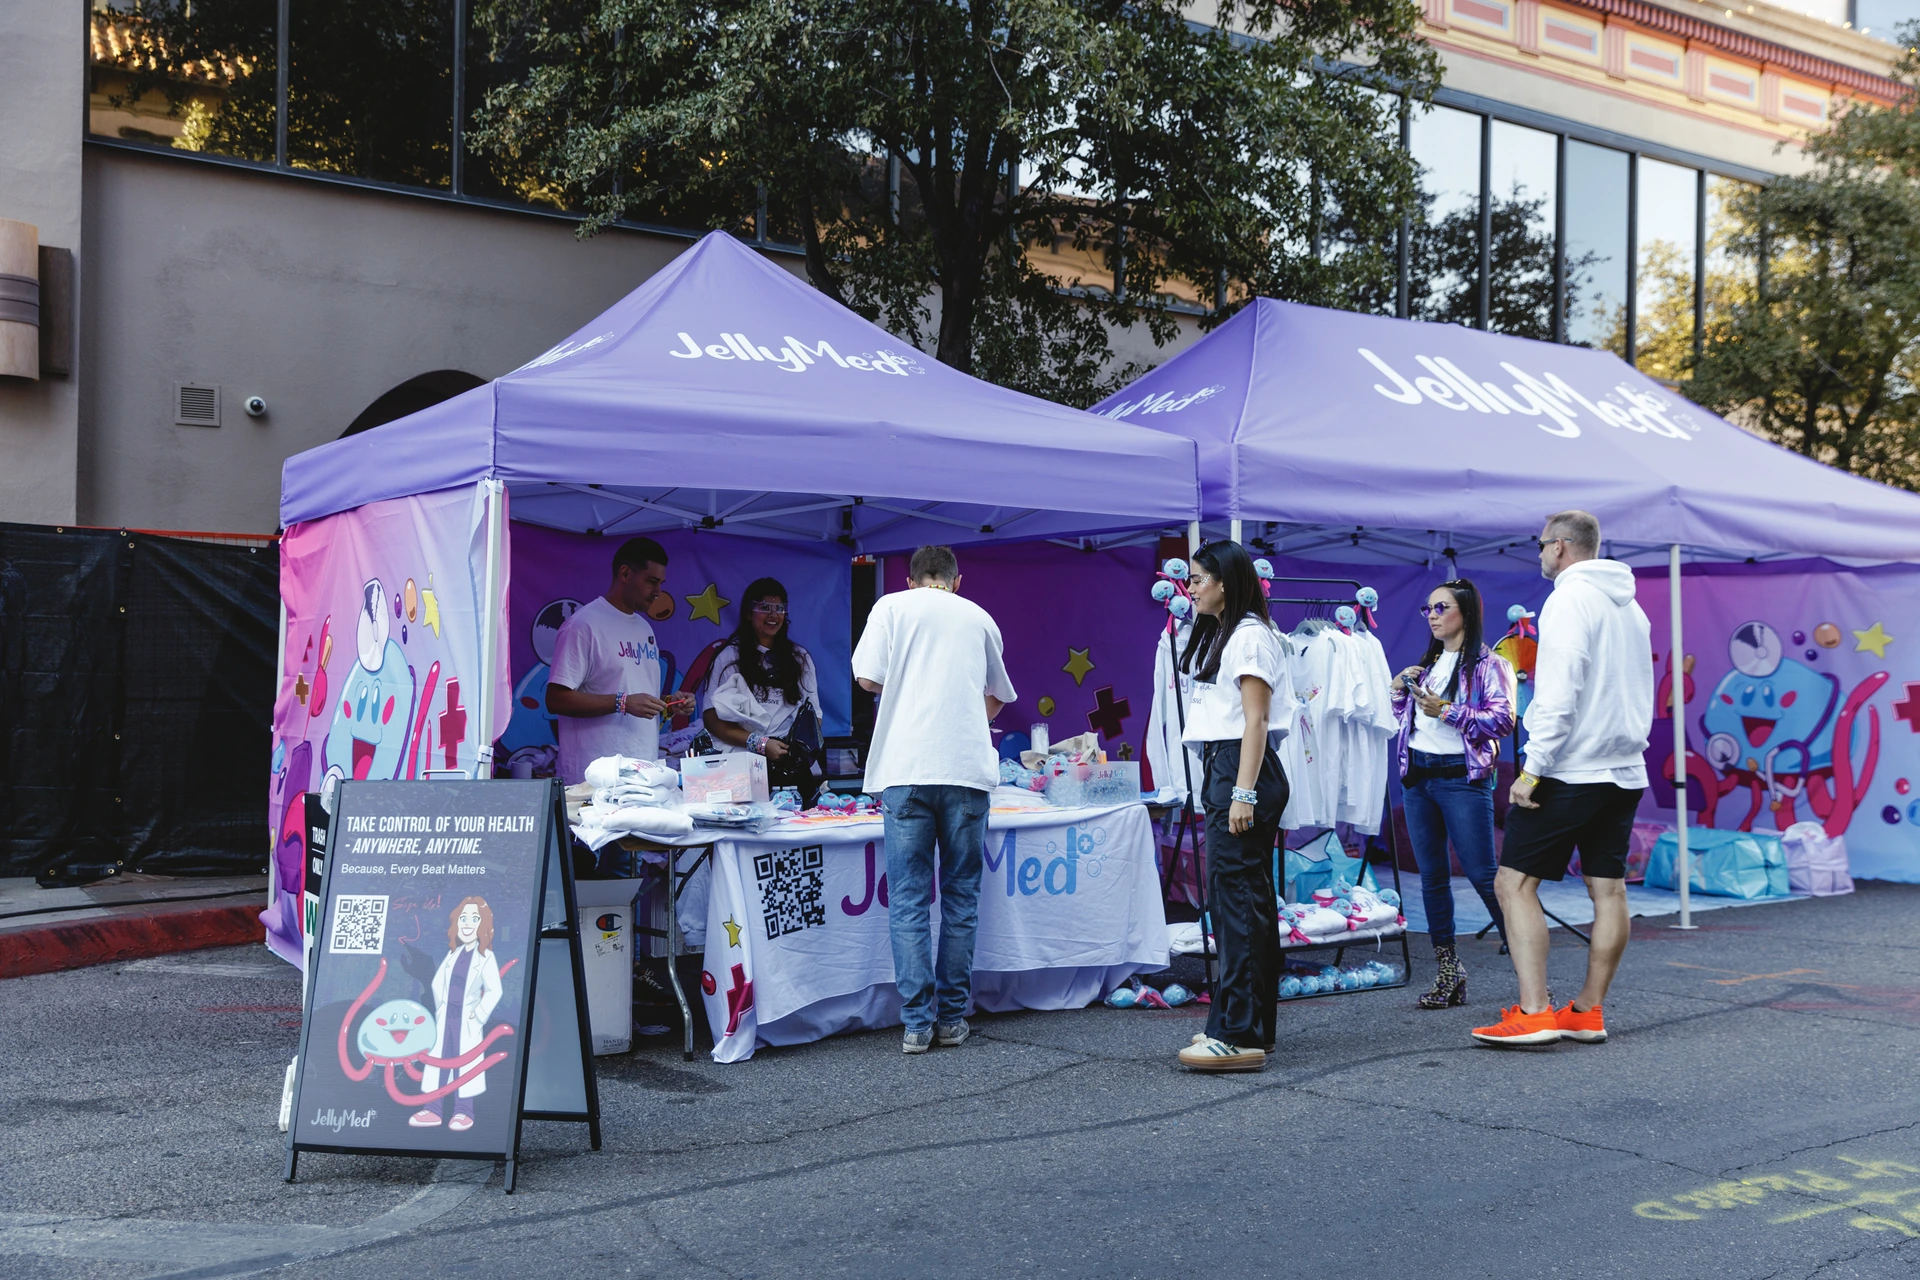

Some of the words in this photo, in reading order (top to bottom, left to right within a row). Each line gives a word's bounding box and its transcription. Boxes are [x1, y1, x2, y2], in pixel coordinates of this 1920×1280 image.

[669, 332, 910, 376] JellyMed
[1357, 348, 1693, 440] JellyMed
[346, 816, 377, 832] TAKE
[379, 816, 432, 833] CONTROL
[435, 816, 451, 833] OF
[454, 816, 485, 833] YOUR
[488, 816, 535, 833] HEALTH
[312, 826, 326, 846] TRASH
[352, 838, 421, 856] ANYWHERE,
[425, 838, 483, 854] ANYTIME.
[312, 857, 324, 876] ONL
[341, 864, 387, 875] Because,
[390, 864, 419, 876] Every
[422, 864, 445, 874] Beat
[448, 864, 486, 875] Matters
[311, 1108, 371, 1133] JellyMed
